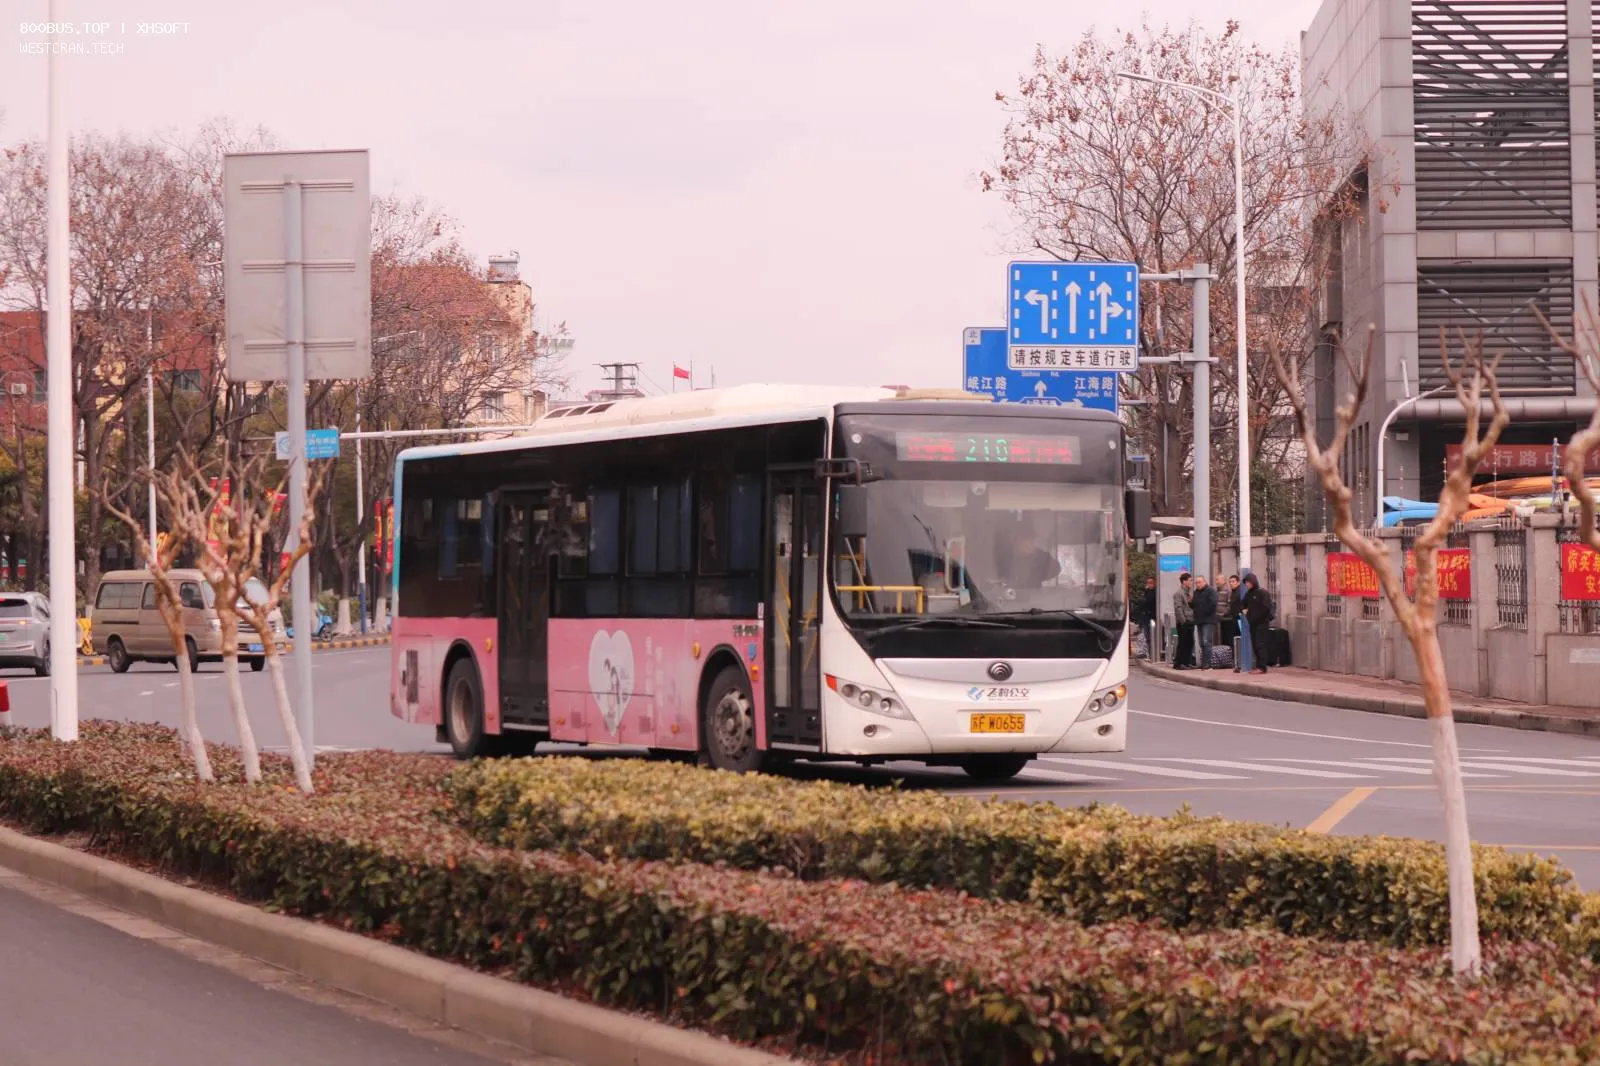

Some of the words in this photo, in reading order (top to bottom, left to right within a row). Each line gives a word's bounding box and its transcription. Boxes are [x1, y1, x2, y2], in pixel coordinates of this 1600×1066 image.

[1014, 349, 1131, 366] 请按规定车道行驶
[1074, 376, 1114, 390] 江海路
[965, 438, 1009, 462] 210
